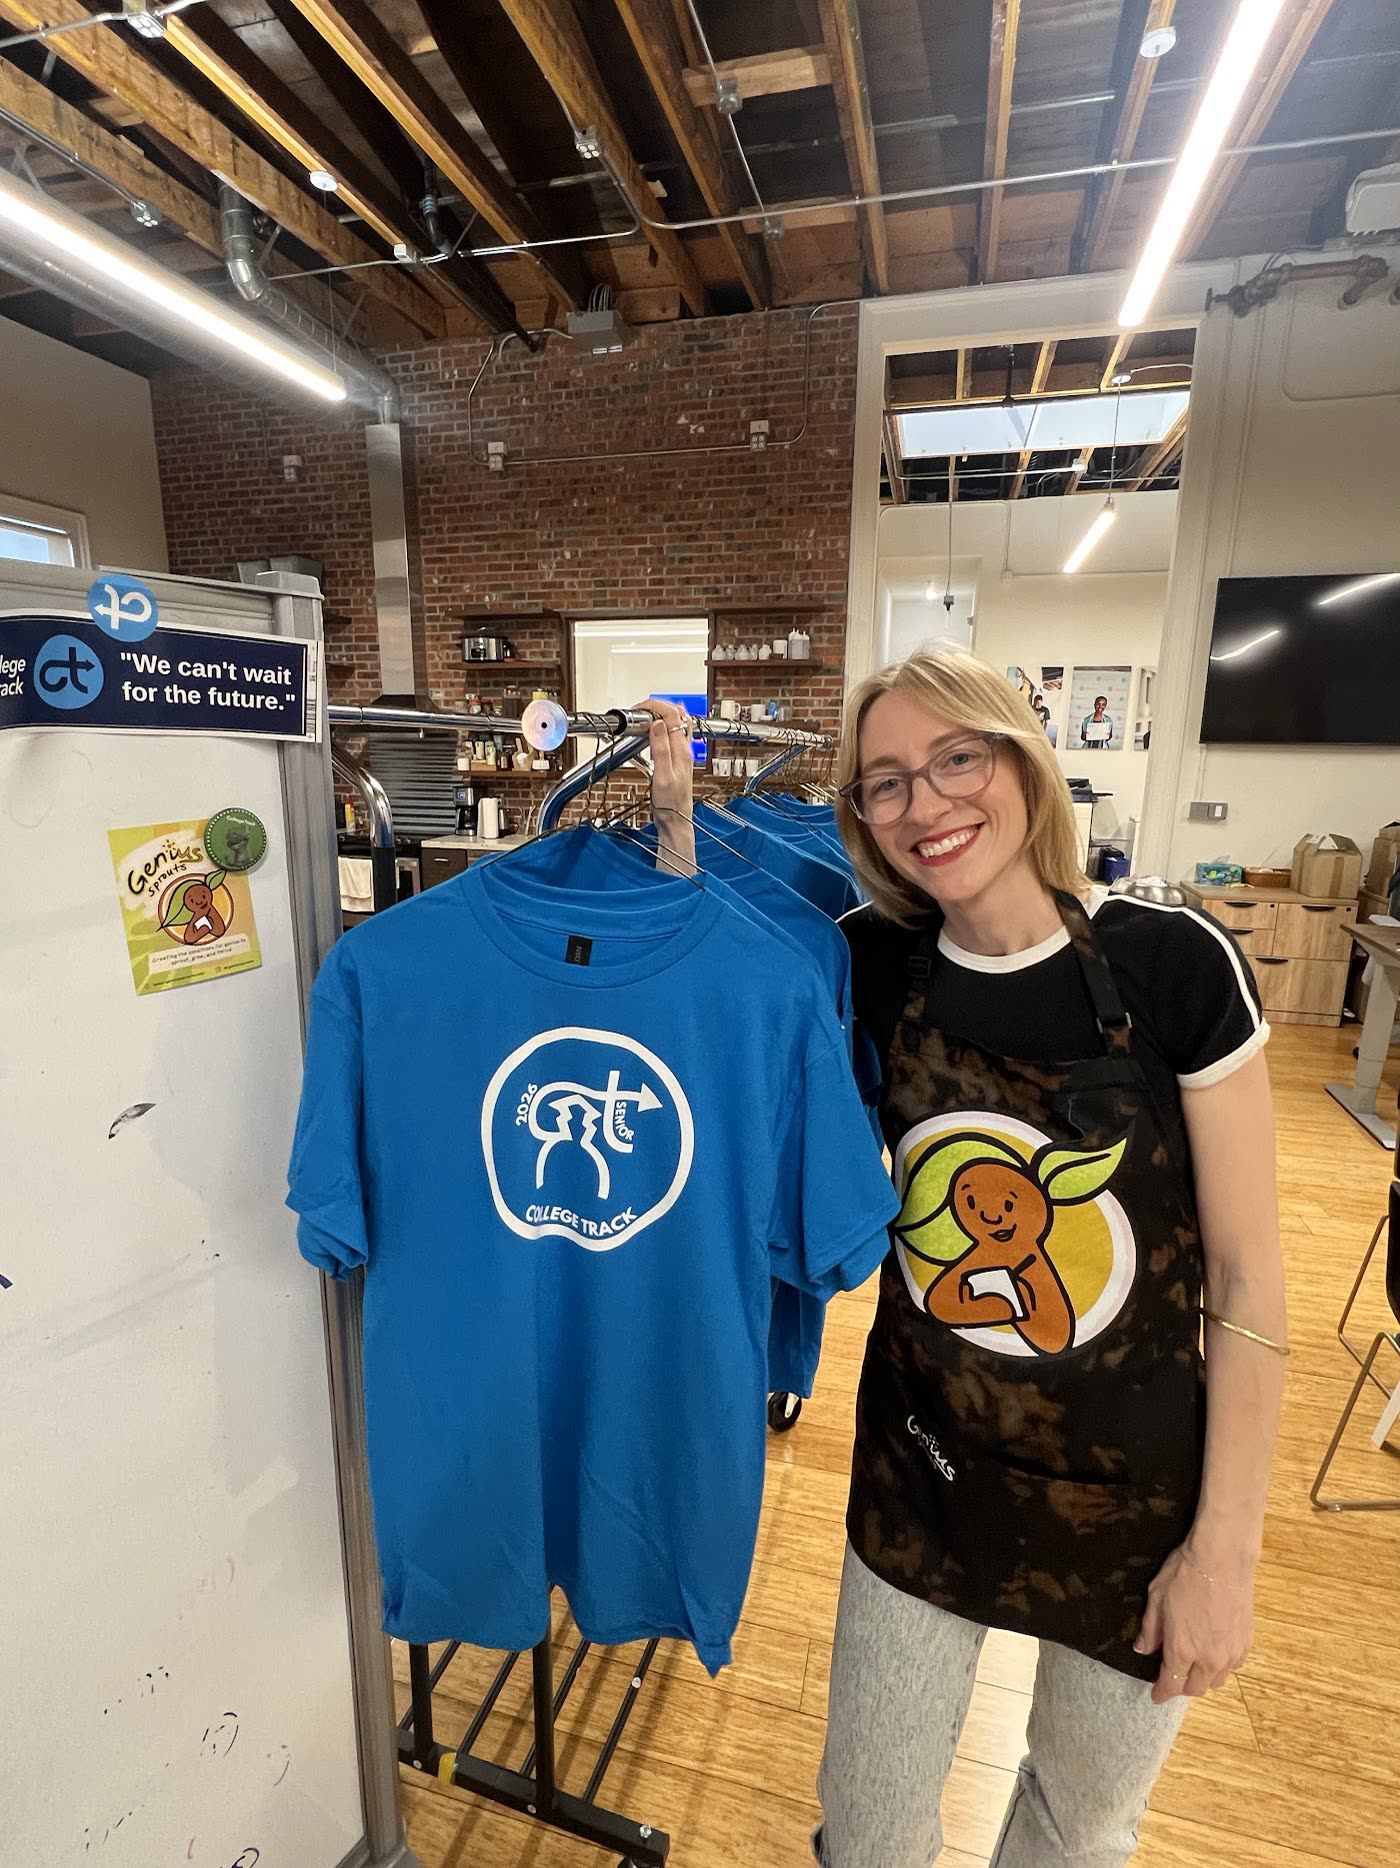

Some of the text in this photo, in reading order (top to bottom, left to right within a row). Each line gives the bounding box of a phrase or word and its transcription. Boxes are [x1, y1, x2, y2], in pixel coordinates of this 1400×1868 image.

[120, 652, 171, 675] "We
[177, 660, 238, 681] can't
[243, 665, 292, 685] wait
[121, 681, 296, 711] for the future."
[128, 840, 204, 895] Genius
[148, 863, 187, 897] sprouts
[515, 1083, 538, 1126] 2026
[614, 1101, 635, 1141] SENIOR
[525, 1204, 638, 1237] COLLEGE TRACK
